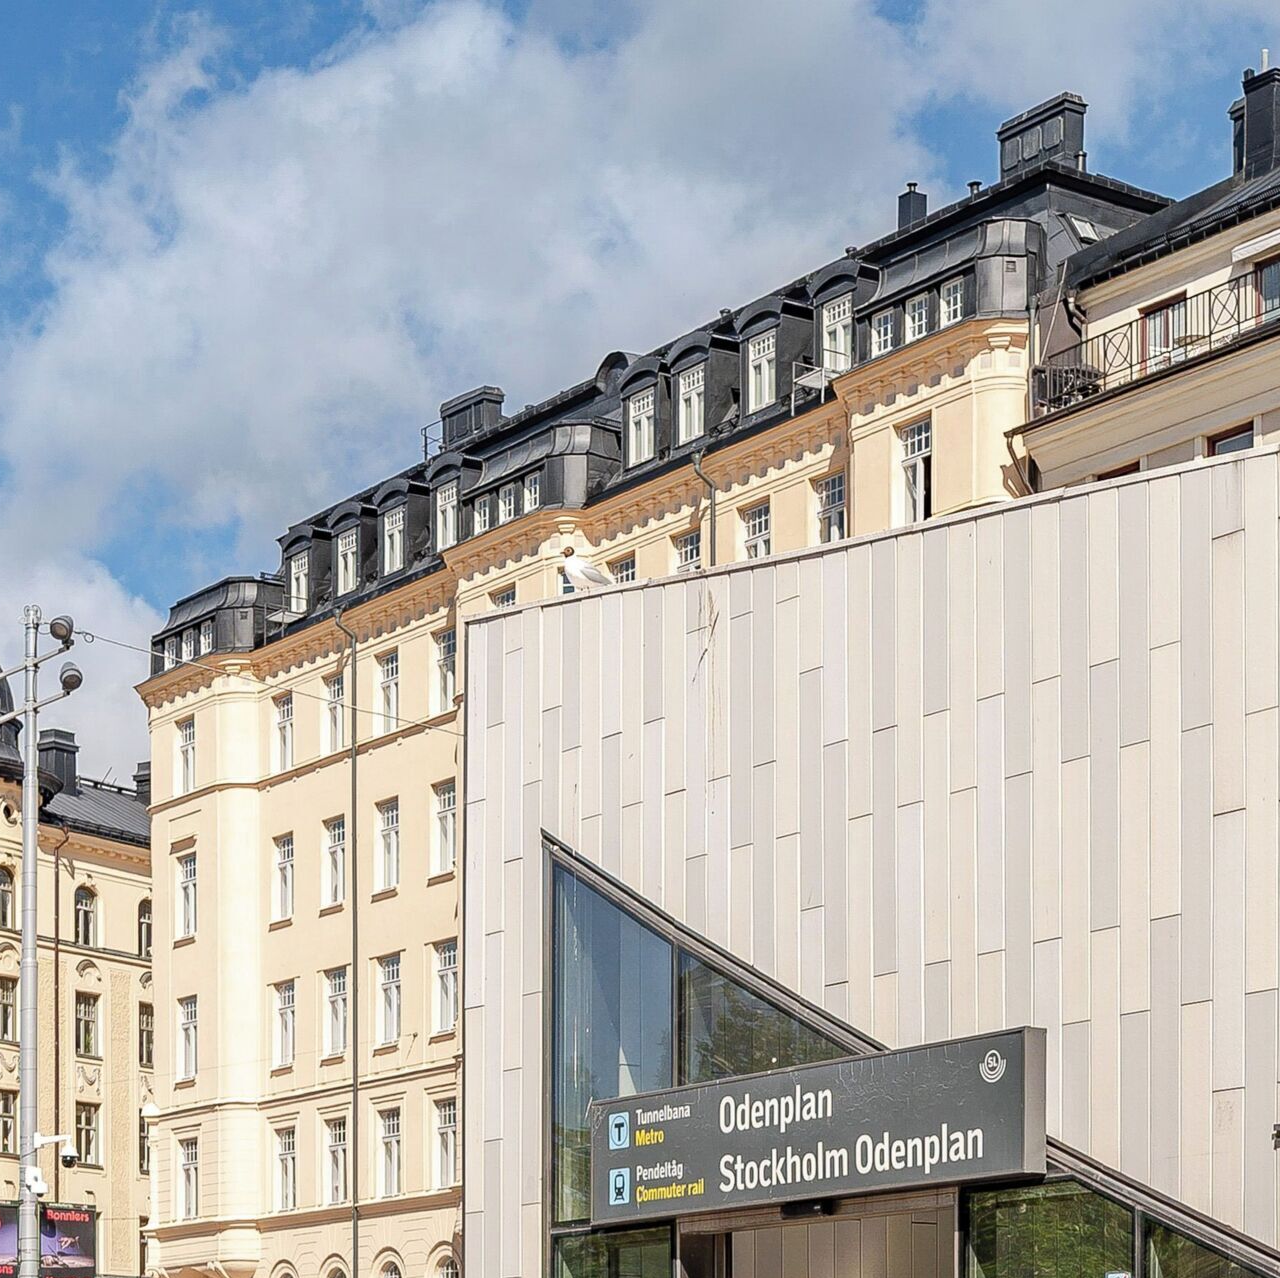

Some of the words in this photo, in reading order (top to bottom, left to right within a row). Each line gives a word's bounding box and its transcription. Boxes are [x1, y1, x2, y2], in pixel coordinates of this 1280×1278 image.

[635, 1104, 691, 1126] Tunnelbana
[719, 1084, 833, 1134] Odenplan
[635, 1128, 665, 1147] Metro
[719, 1141, 849, 1193] Stockholm
[855, 1123, 984, 1175] Odenplan
[636, 1159, 684, 1182] Pendeltåg
[636, 1182, 686, 1203] Commuter
[687, 1177, 705, 1195] rail
[46, 1209, 90, 1222] Bonniers
